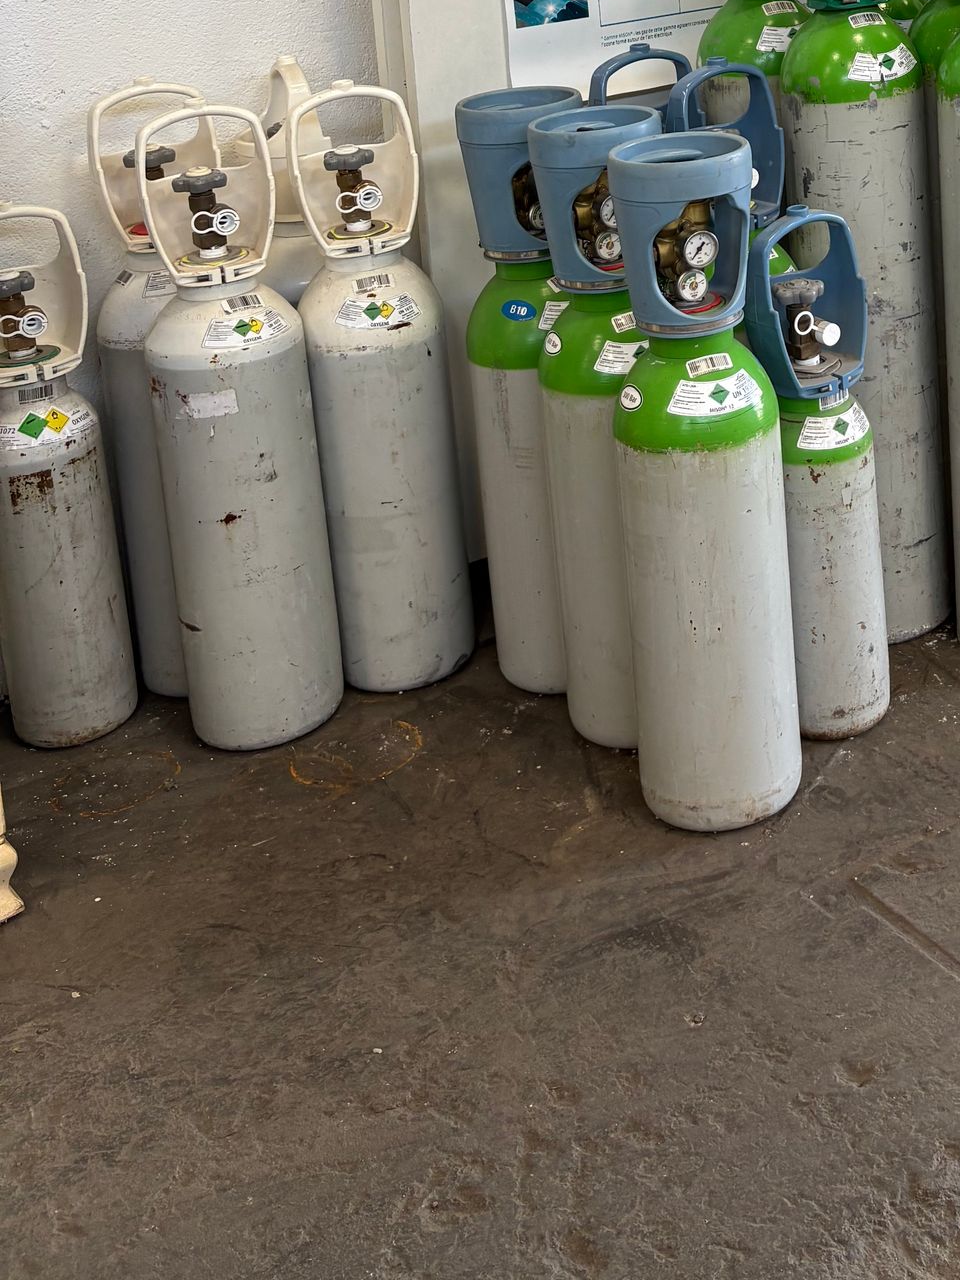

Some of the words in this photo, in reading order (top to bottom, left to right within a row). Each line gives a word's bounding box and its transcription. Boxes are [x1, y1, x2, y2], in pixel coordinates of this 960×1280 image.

[509, 304, 528, 317] B10
[629, 393, 638, 404] Bar
[732, 390, 742, 399] UN
